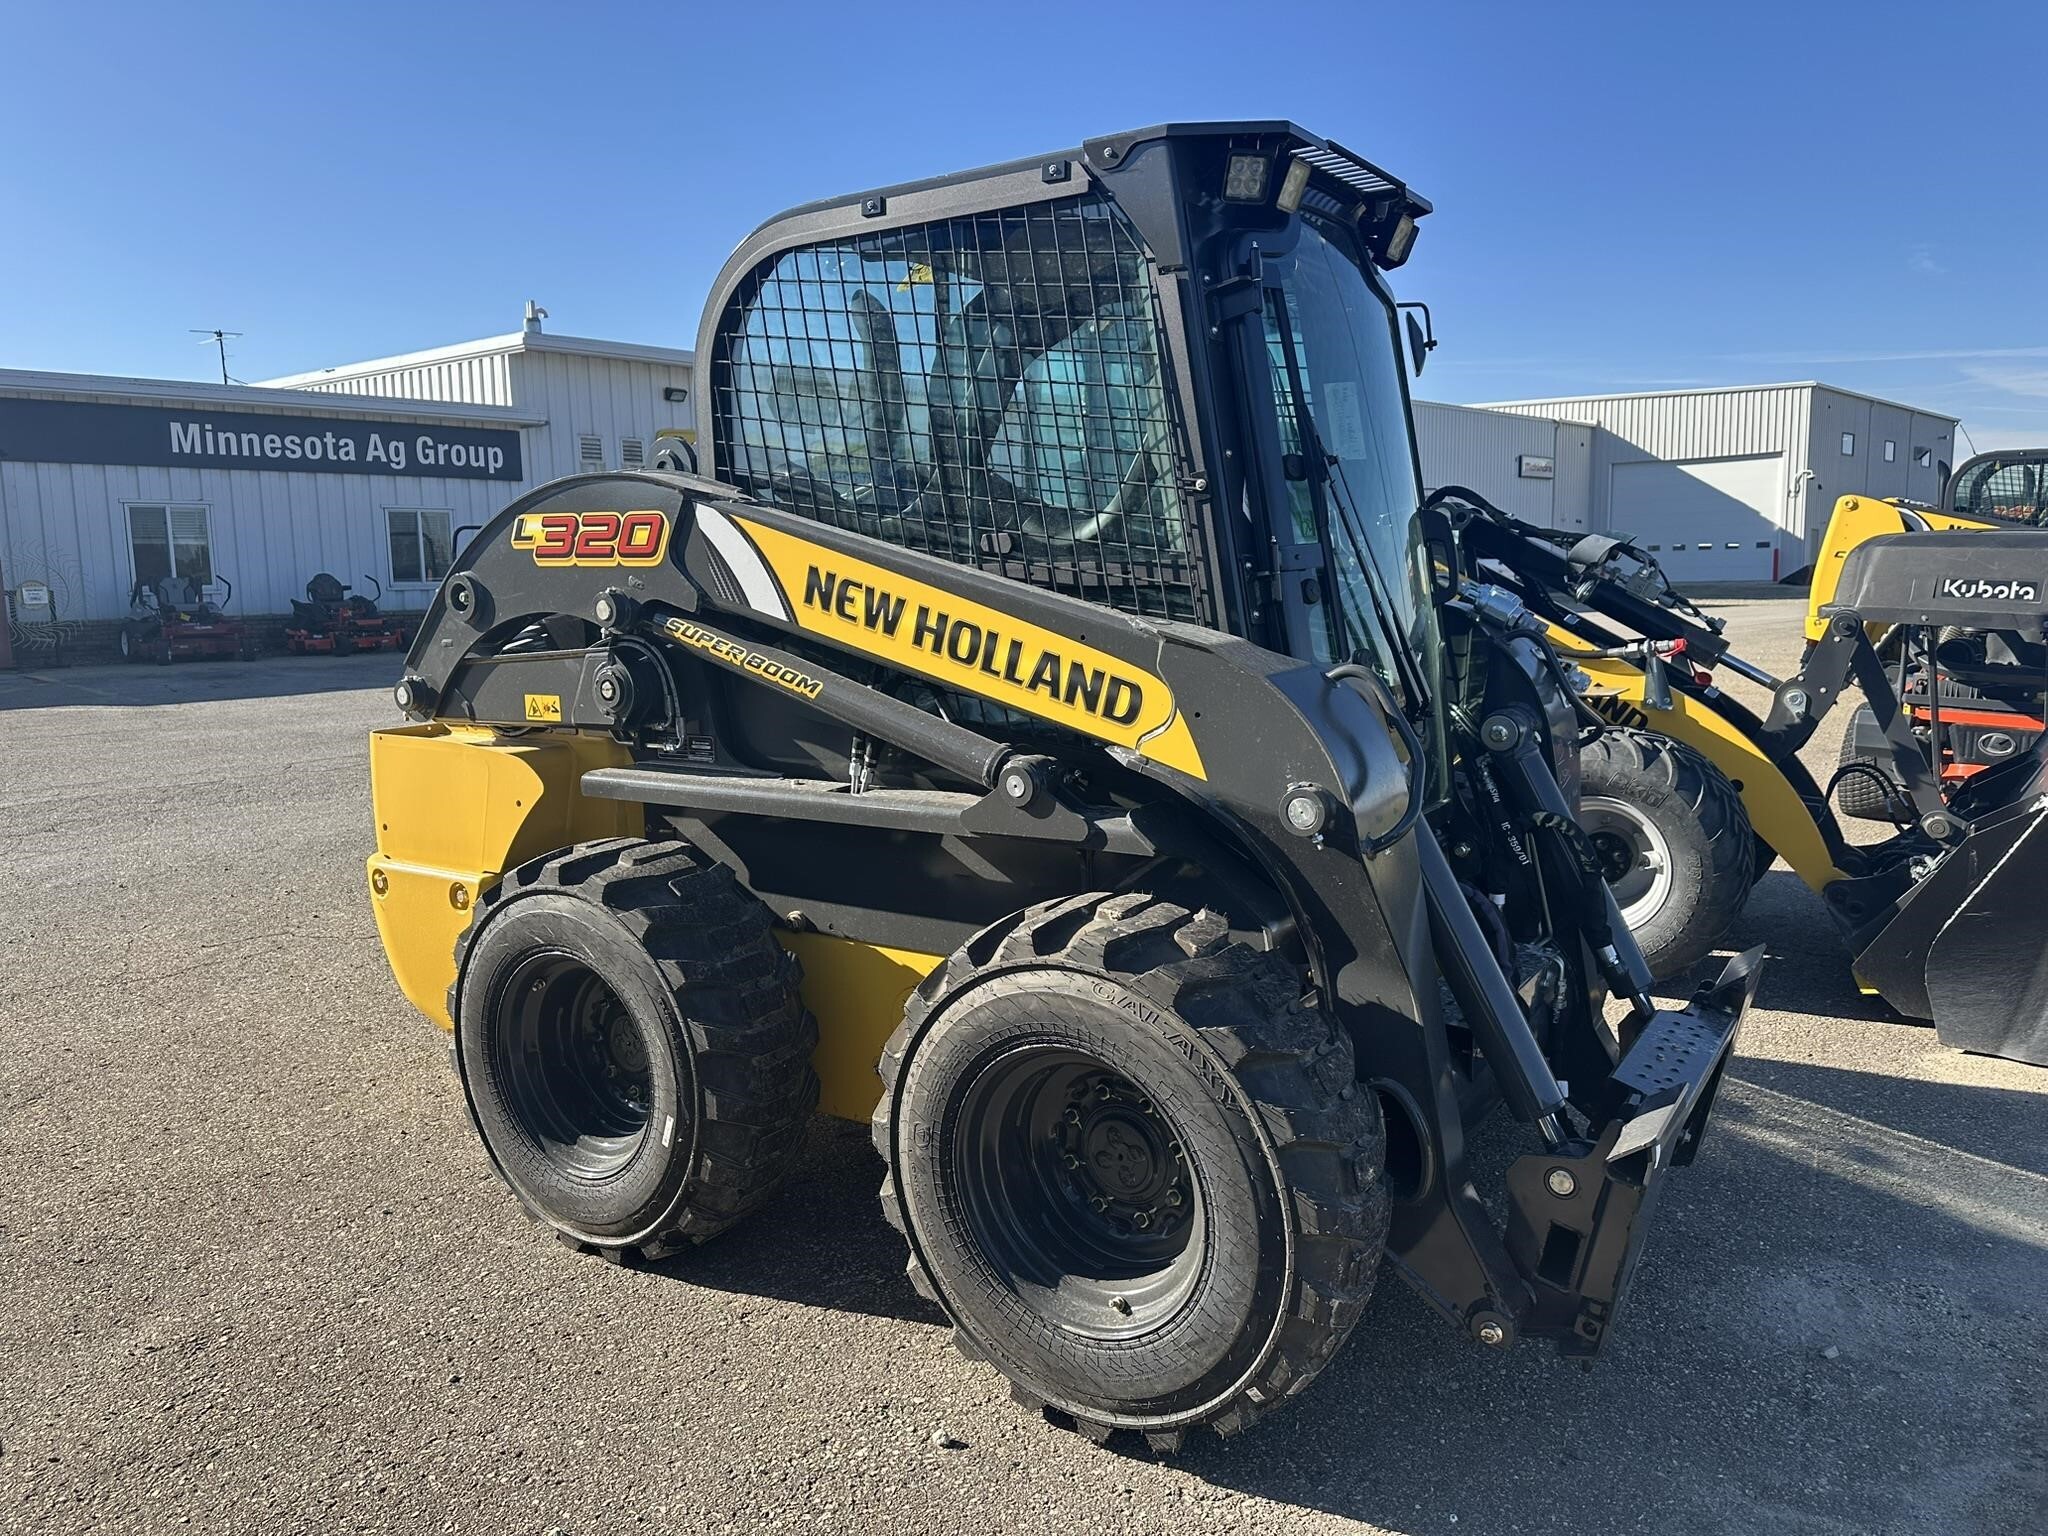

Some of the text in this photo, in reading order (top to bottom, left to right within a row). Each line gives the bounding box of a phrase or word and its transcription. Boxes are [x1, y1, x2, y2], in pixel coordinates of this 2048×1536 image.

[170, 422, 504, 474] Minnesota Ag Group
[512, 511, 668, 563] L320
[1943, 578, 2035, 600] Kubota
[666, 618, 823, 698] SUPER BOOM
[803, 564, 1144, 727] NEW HOLLAND
[1091, 981, 1247, 1118] GALAXY
